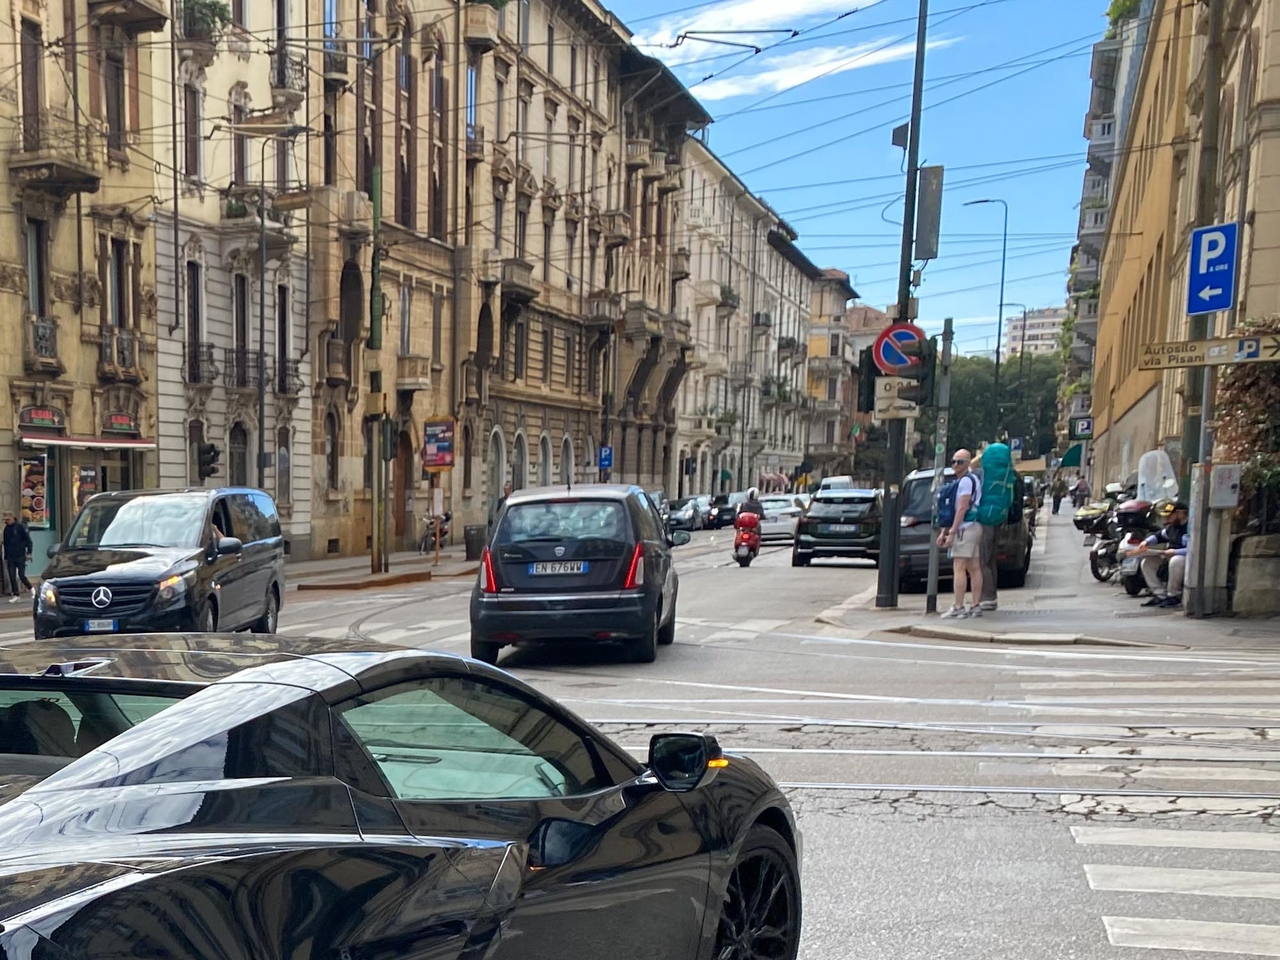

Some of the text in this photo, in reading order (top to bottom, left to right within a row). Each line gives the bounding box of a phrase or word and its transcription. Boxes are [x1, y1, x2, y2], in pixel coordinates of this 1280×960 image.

[1199, 231, 1226, 274] P
[1144, 343, 1197, 356] Autosilo
[1241, 340, 1256, 359] P
[1144, 352, 1205, 366] via Pisani
[1078, 421, 1087, 432] P
[1011, 439, 1019, 449] P
[601, 447, 610, 458] P
[535, 563, 547, 573] EN
[550, 561, 582, 572] 676WW
